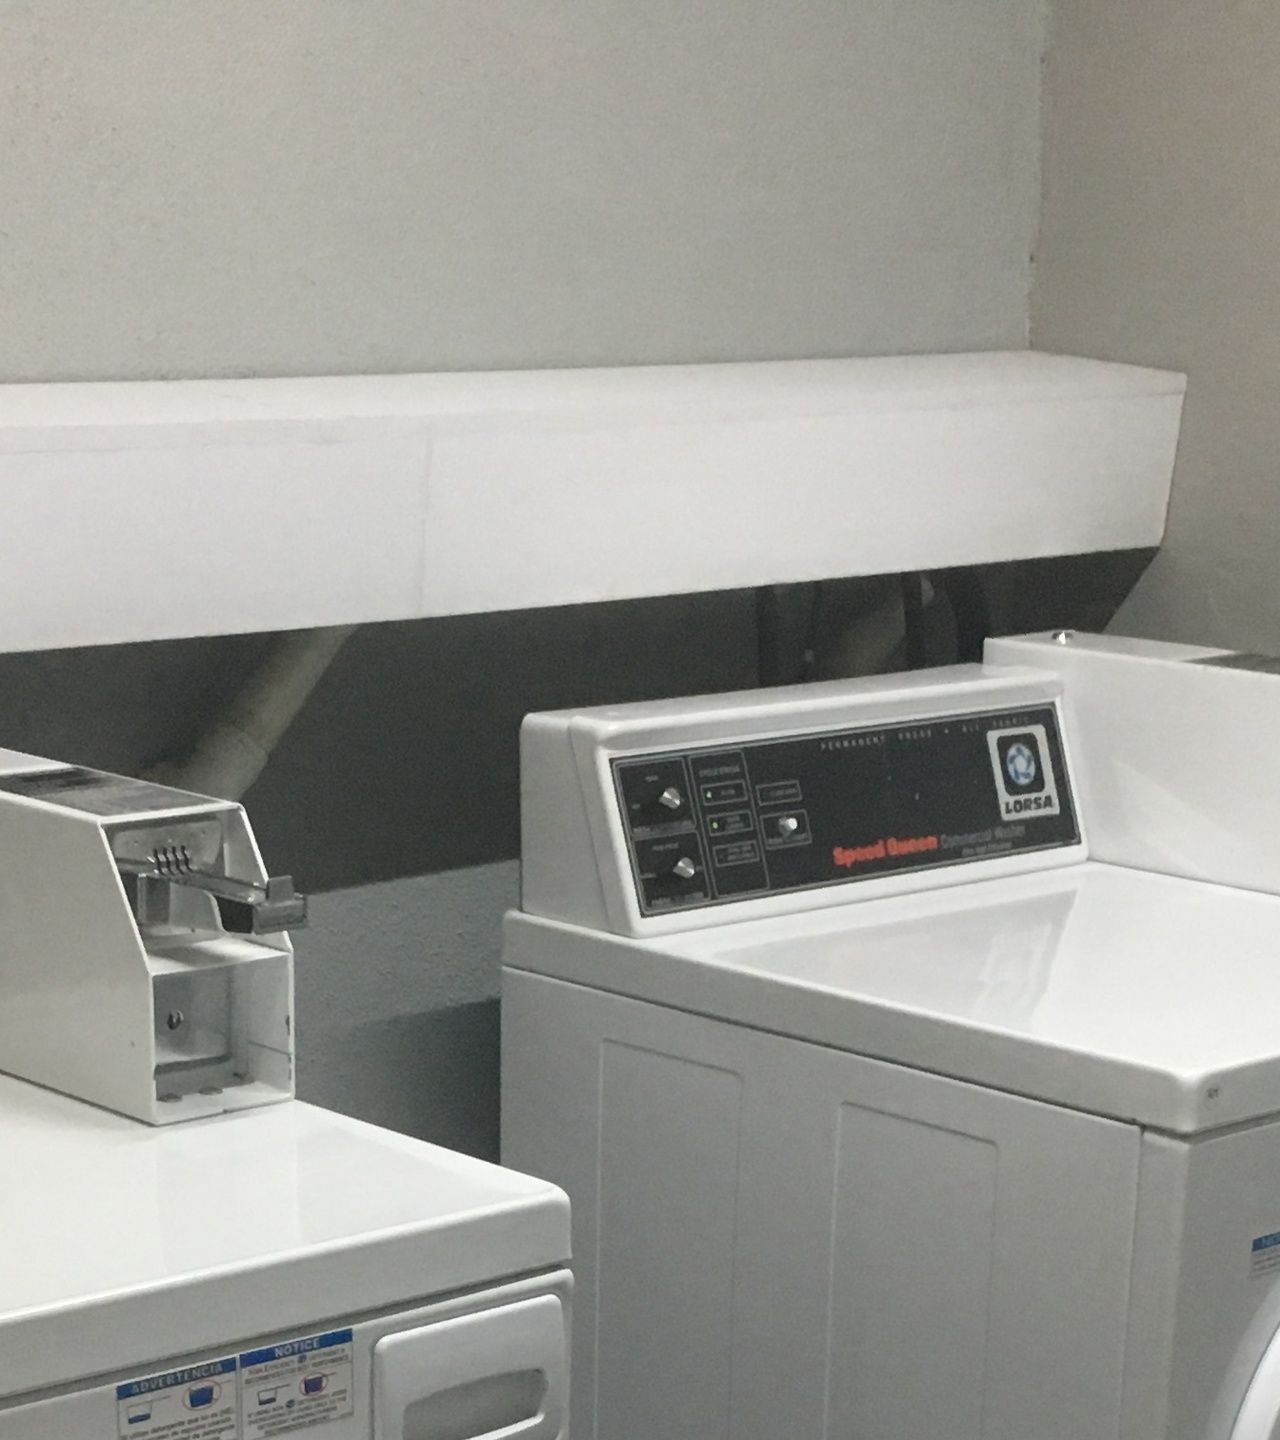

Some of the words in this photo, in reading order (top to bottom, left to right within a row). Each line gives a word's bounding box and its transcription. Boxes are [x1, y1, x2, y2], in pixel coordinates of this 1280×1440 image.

[1005, 795, 1053, 814] LORSA
[832, 841, 886, 868] Speed
[888, 834, 938, 858] Queen
[274, 1338, 320, 1357] NOTICE
[131, 1362, 223, 1394] ADVERTENCIA
